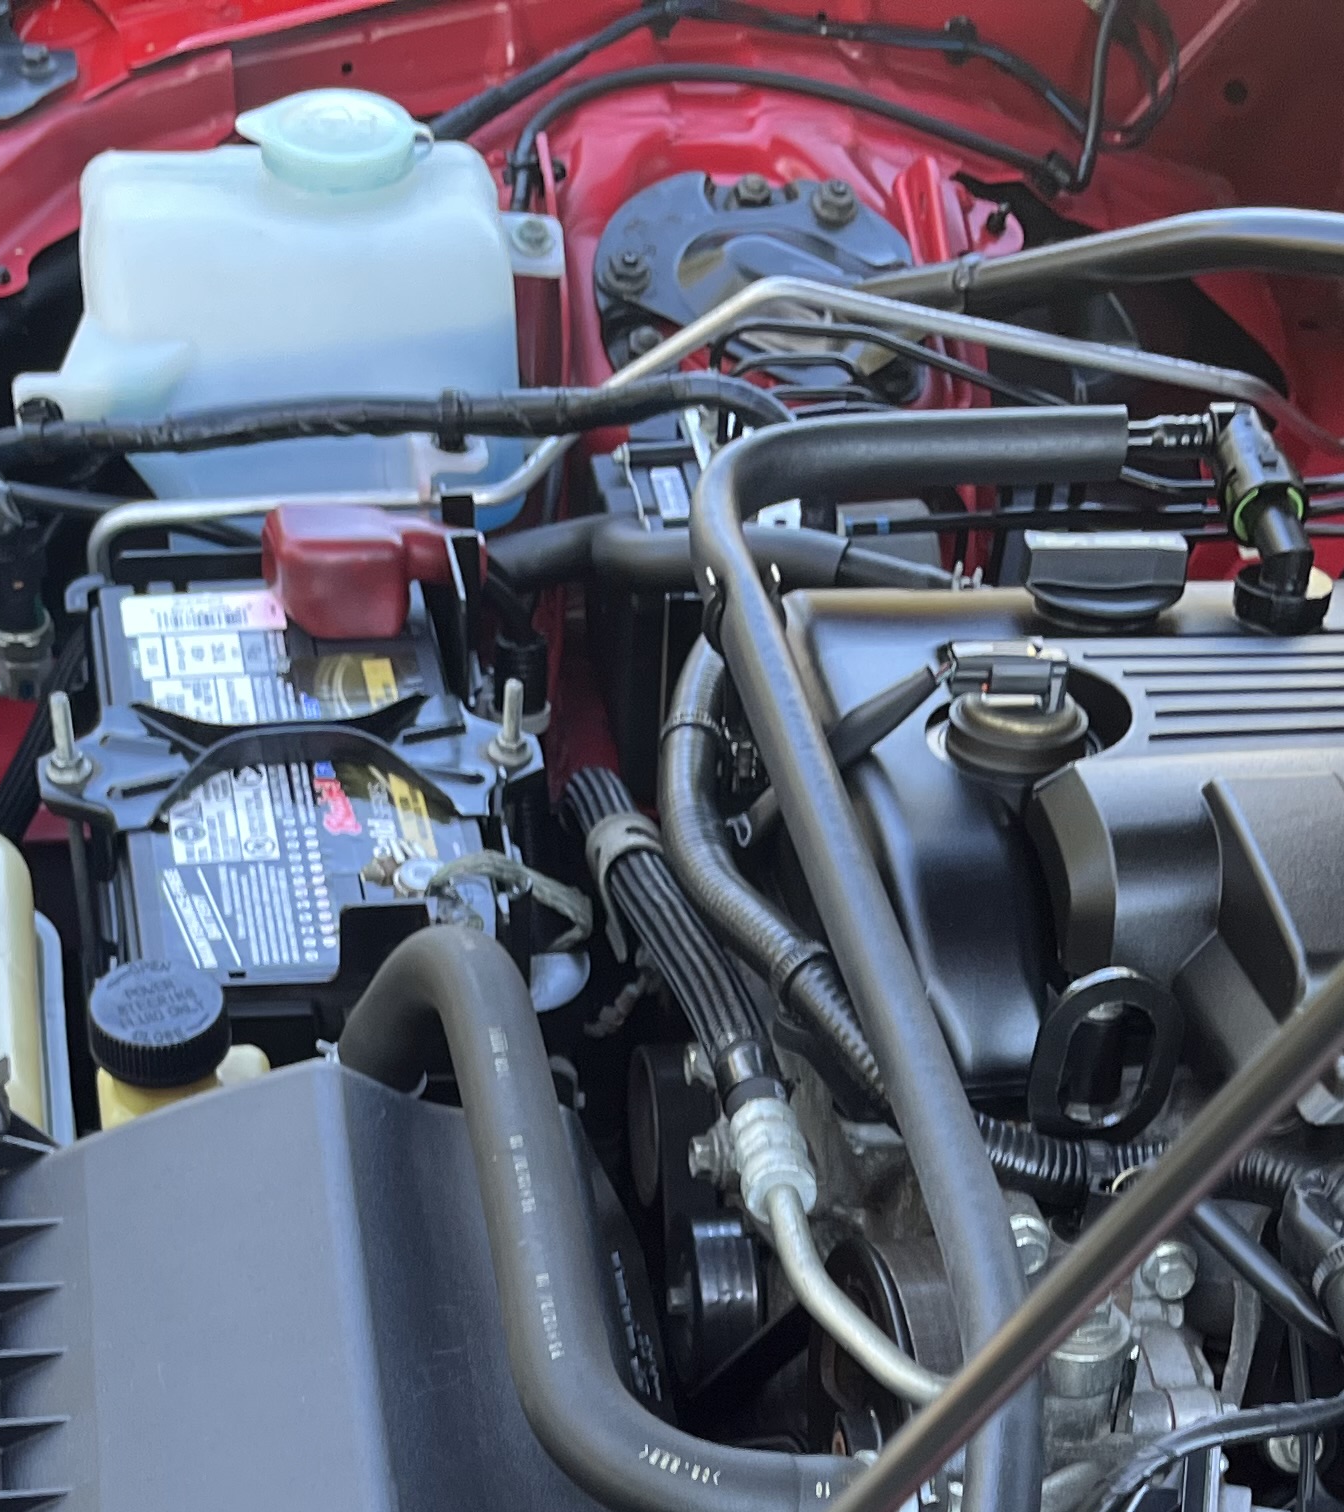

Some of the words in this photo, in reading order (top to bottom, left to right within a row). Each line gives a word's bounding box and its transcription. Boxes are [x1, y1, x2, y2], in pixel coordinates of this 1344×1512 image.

[129, 960, 172, 974] OPEN
[124, 978, 176, 999] POWER
[117, 987, 197, 1016] STEERING
[120, 1009, 165, 1030] FLUID
[167, 1001, 205, 1018] ONLY
[132, 1026, 187, 1043] CLOSE
